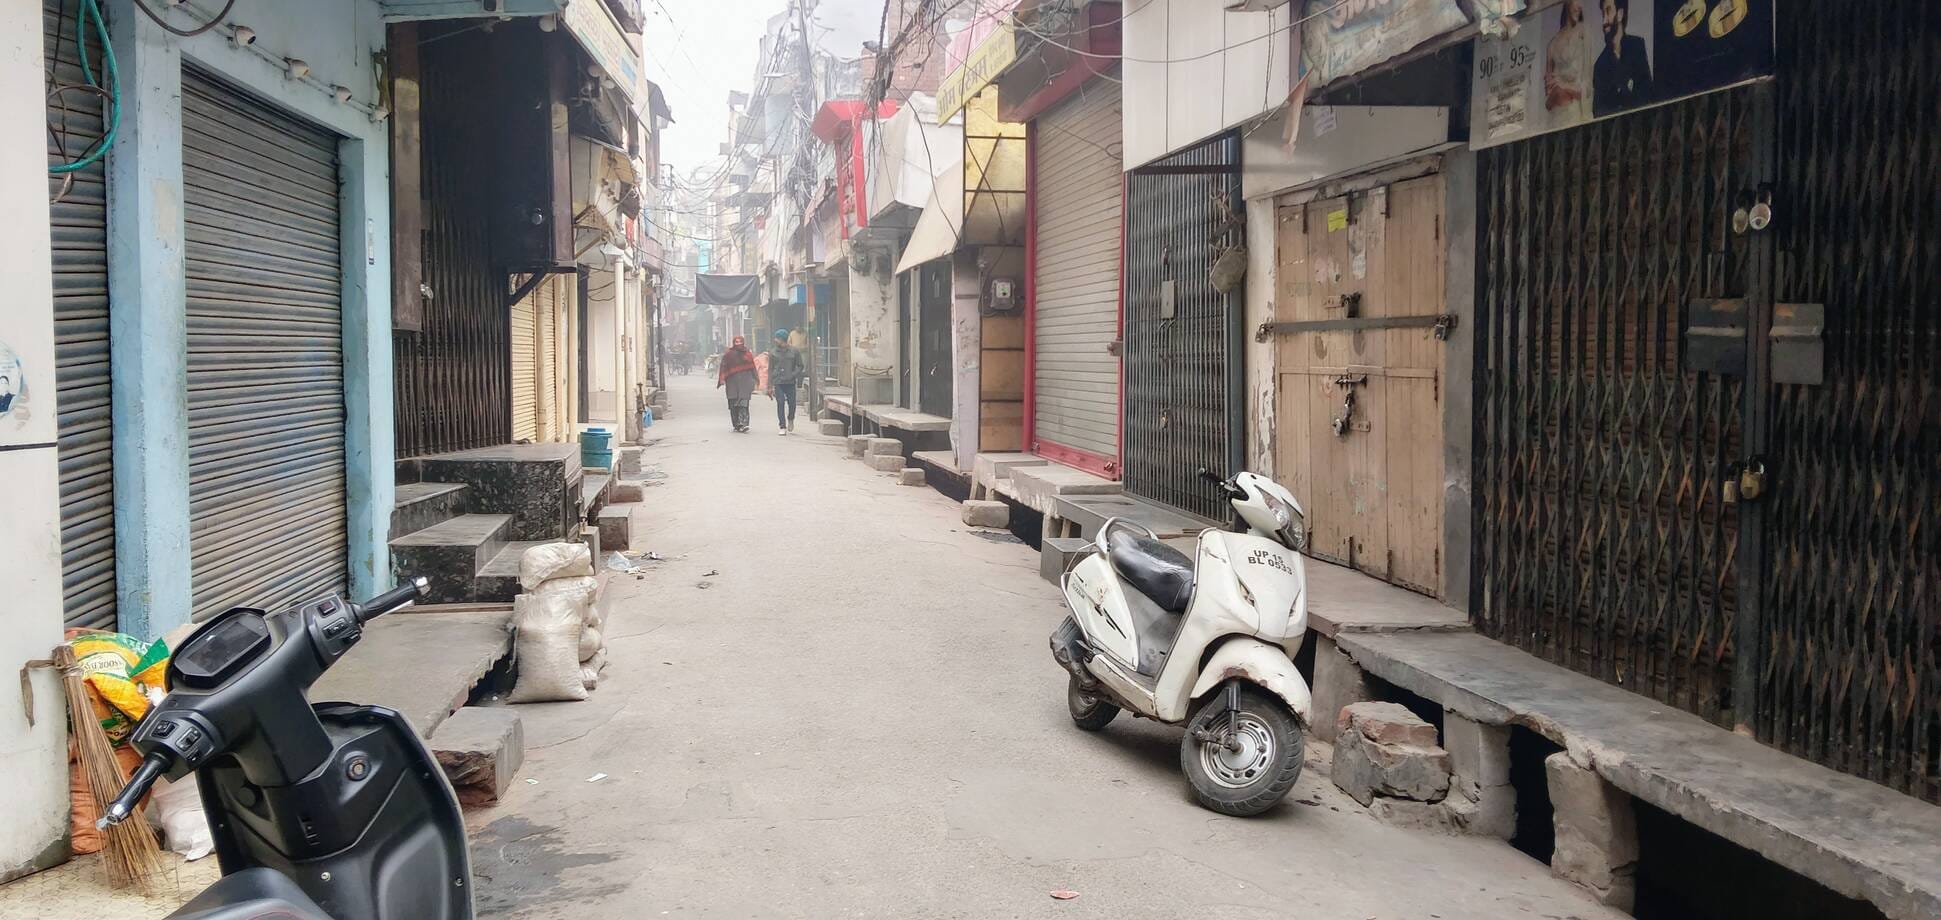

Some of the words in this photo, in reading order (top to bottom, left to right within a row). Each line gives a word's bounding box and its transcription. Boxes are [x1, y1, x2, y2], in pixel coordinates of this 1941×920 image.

[1254, 550, 1269, 558] UP
[1248, 556, 1265, 565] BL
[1268, 559, 1293, 575] 0533
